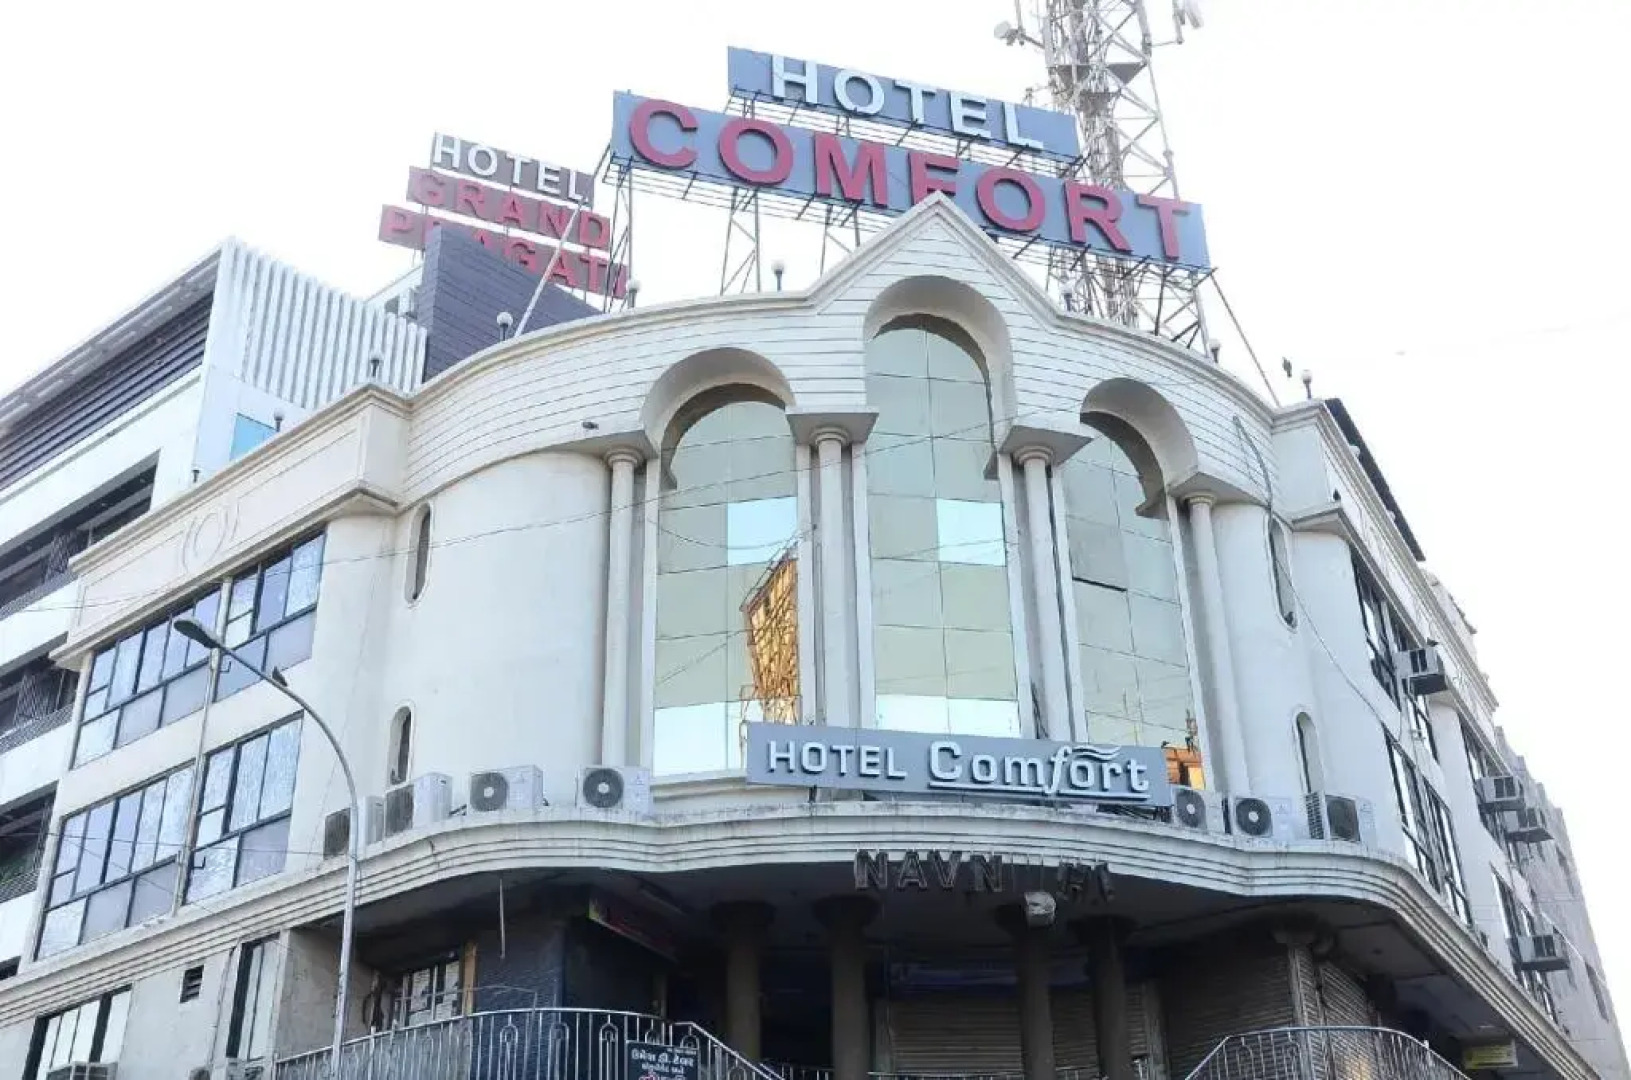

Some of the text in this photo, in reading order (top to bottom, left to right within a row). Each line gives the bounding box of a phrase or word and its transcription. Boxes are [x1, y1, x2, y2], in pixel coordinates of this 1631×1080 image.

[771, 54, 1045, 150] HOTEL
[433, 132, 586, 201] HOTEL
[629, 99, 1191, 261] COMFORT
[414, 171, 611, 248] GRAND
[768, 740, 1150, 796] HOTEL Comfort
